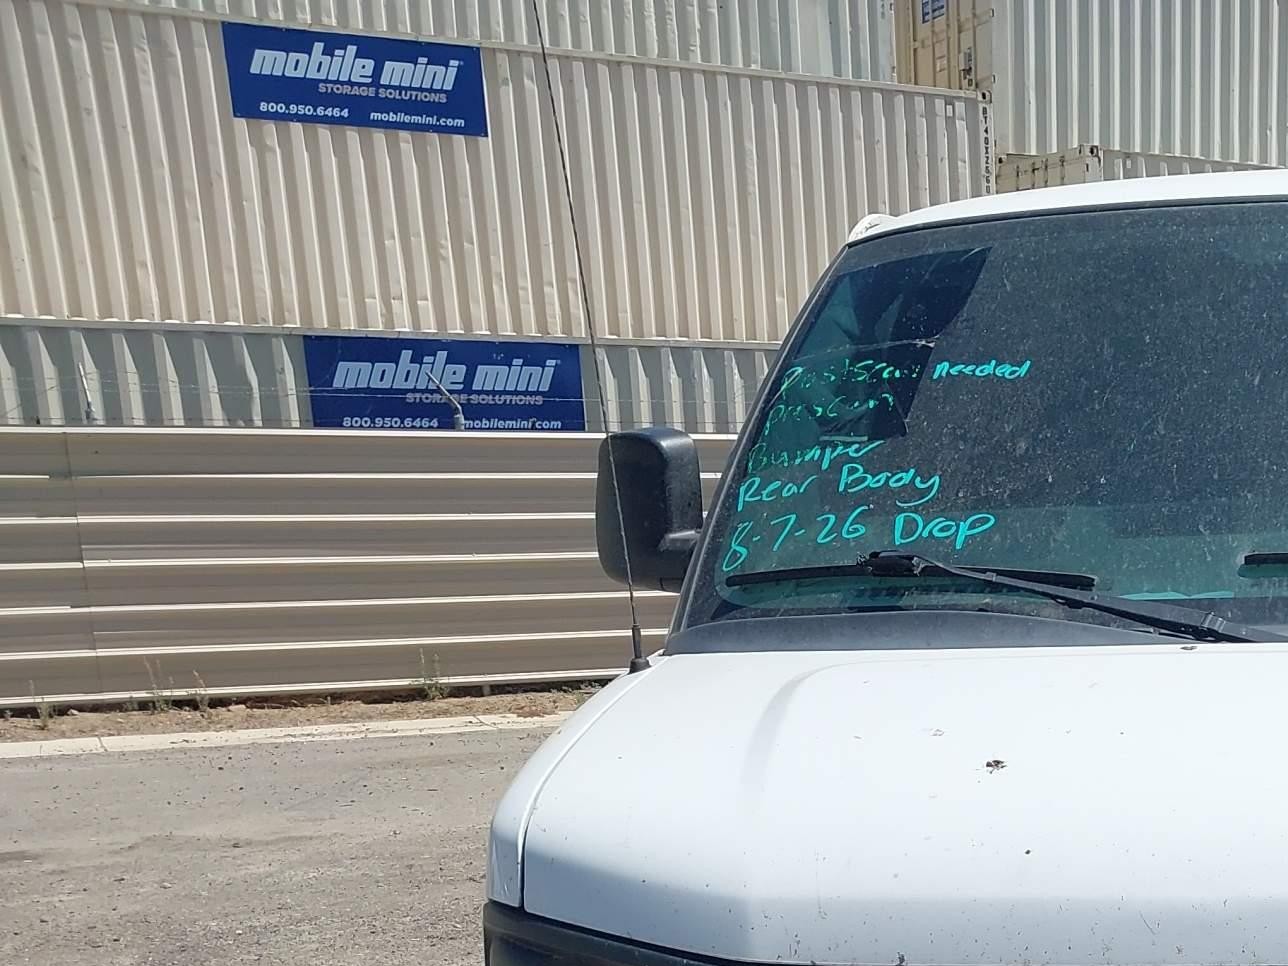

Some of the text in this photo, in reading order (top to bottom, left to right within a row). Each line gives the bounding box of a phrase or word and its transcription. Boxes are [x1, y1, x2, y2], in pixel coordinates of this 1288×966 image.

[250, 42, 460, 90] mobile mini
[317, 83, 448, 103] STORAGE SOLUTIONS
[259, 102, 465, 127] 800.950.6464 mobilemini.com
[332, 350, 557, 392] mobile mini
[933, 360, 1031, 379] needed
[342, 417, 562, 429] 800.950.6464 mobileminicom
[737, 463, 940, 512] Rear Body
[722, 506, 996, 572] 8-7-26 Drop
